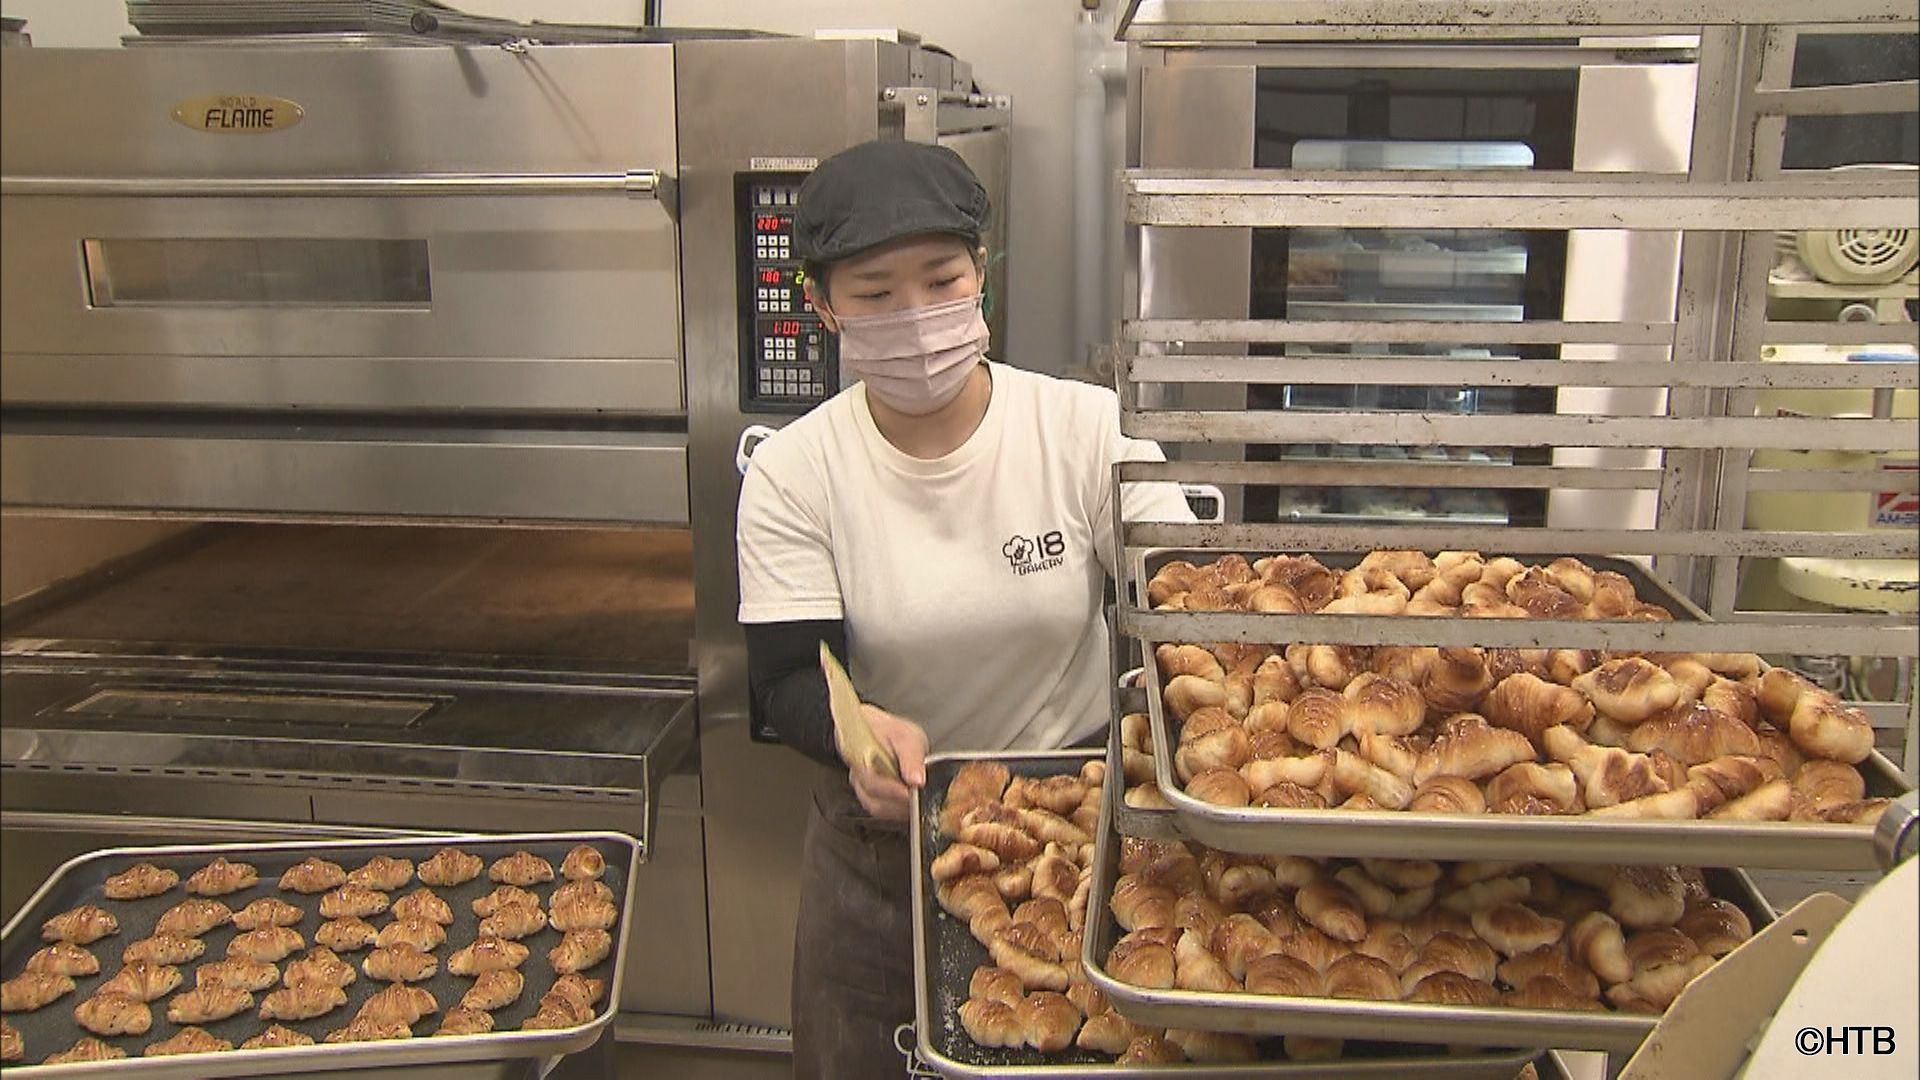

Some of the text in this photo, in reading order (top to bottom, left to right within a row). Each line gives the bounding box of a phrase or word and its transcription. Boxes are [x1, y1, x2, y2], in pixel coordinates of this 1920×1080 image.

[205, 108, 274, 129] FLAME
[762, 270, 780, 283] 180
[1036, 531, 1065, 559] 18
